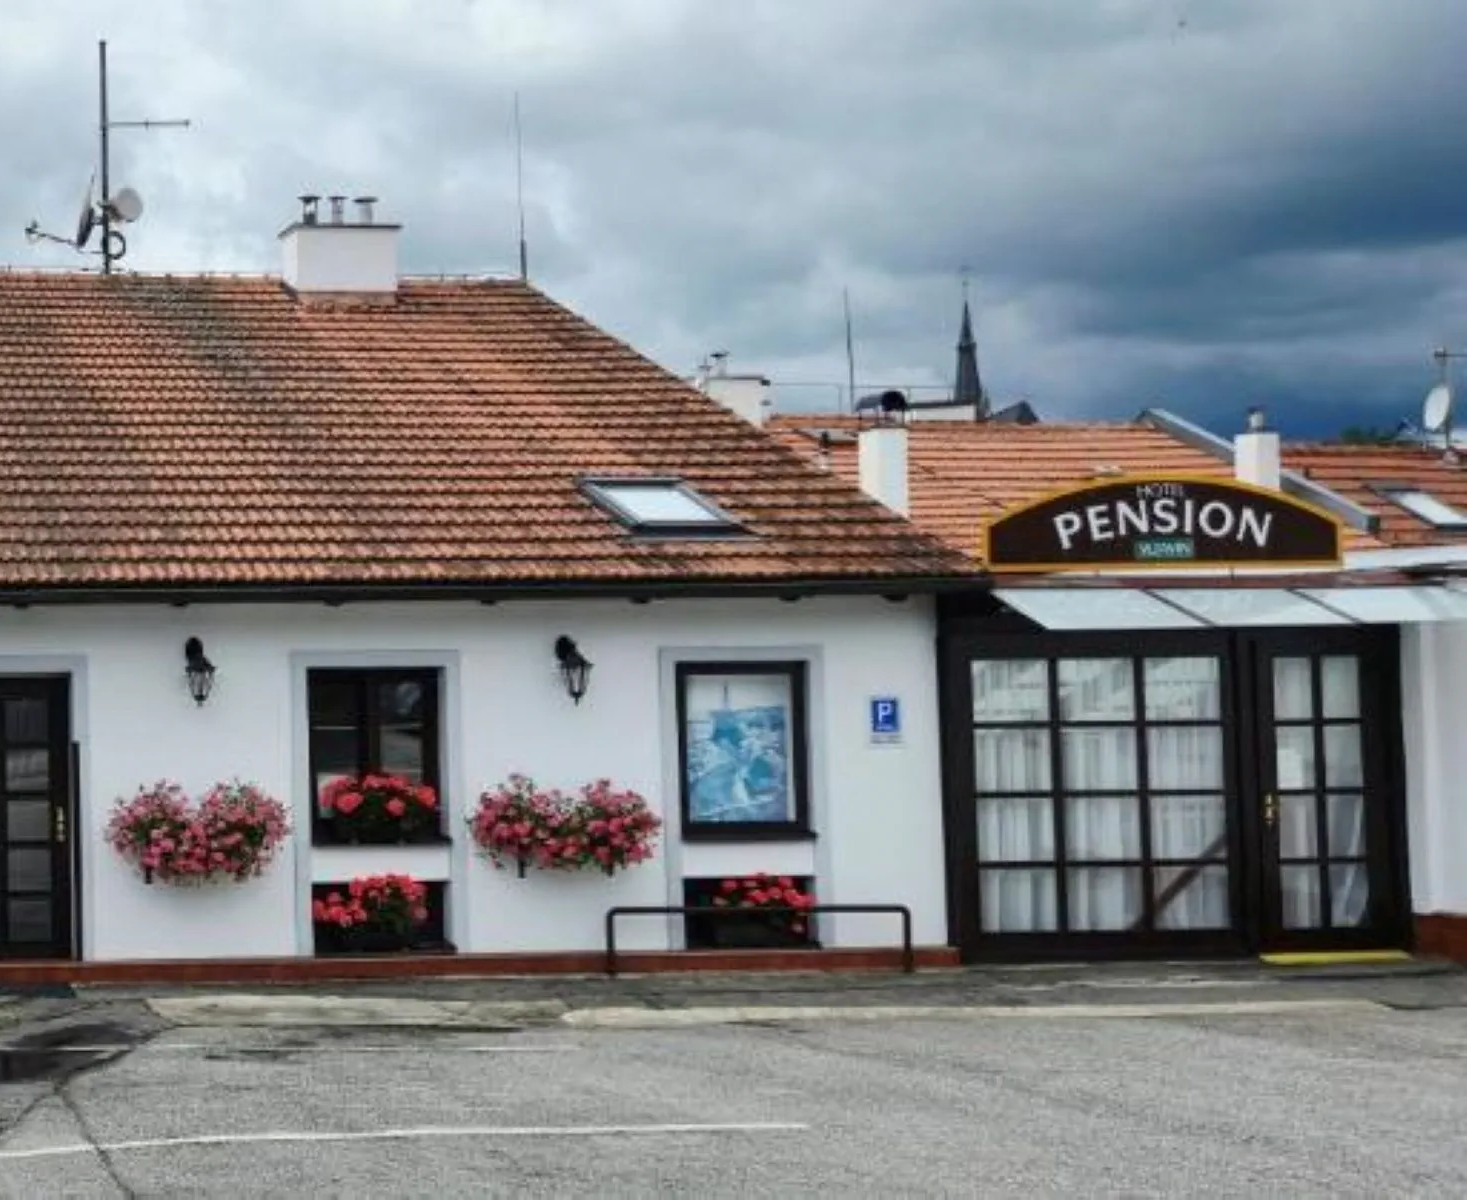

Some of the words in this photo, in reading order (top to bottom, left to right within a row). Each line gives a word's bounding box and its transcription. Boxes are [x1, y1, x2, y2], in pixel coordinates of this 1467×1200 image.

[1136, 484, 1184, 498] HOTEL
[1053, 499, 1273, 549] PENSION
[877, 702, 892, 723] P
